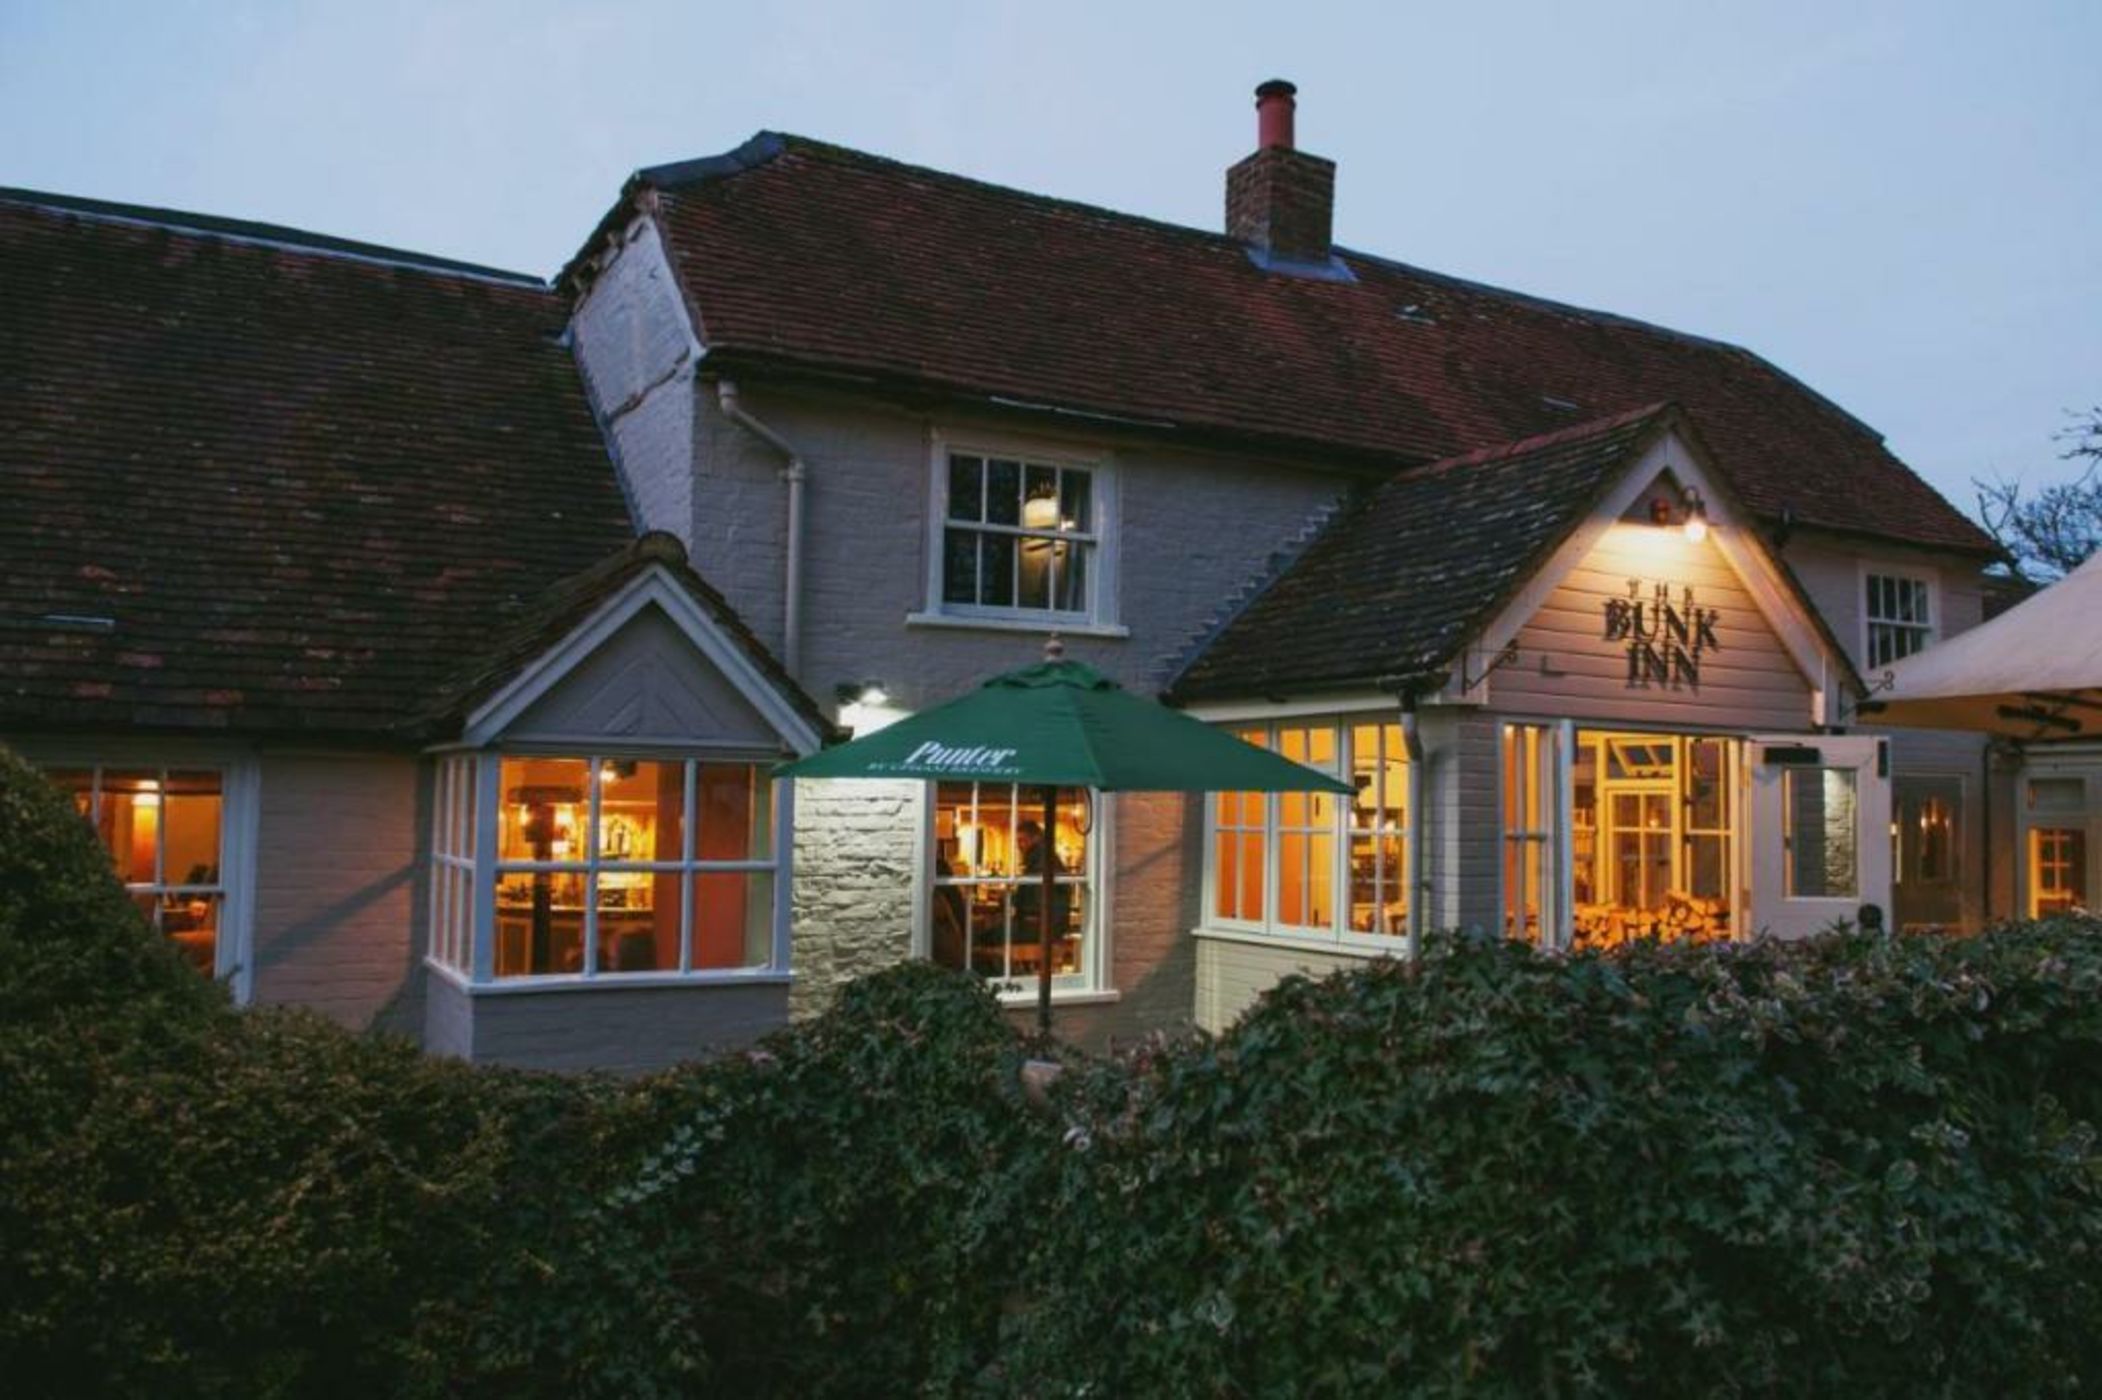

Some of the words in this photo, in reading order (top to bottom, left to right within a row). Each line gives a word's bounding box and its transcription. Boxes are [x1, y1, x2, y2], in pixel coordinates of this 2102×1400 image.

[1603, 598, 1720, 653] BUNK
[1626, 641, 1700, 695] INN
[904, 740, 1018, 767] Punter
